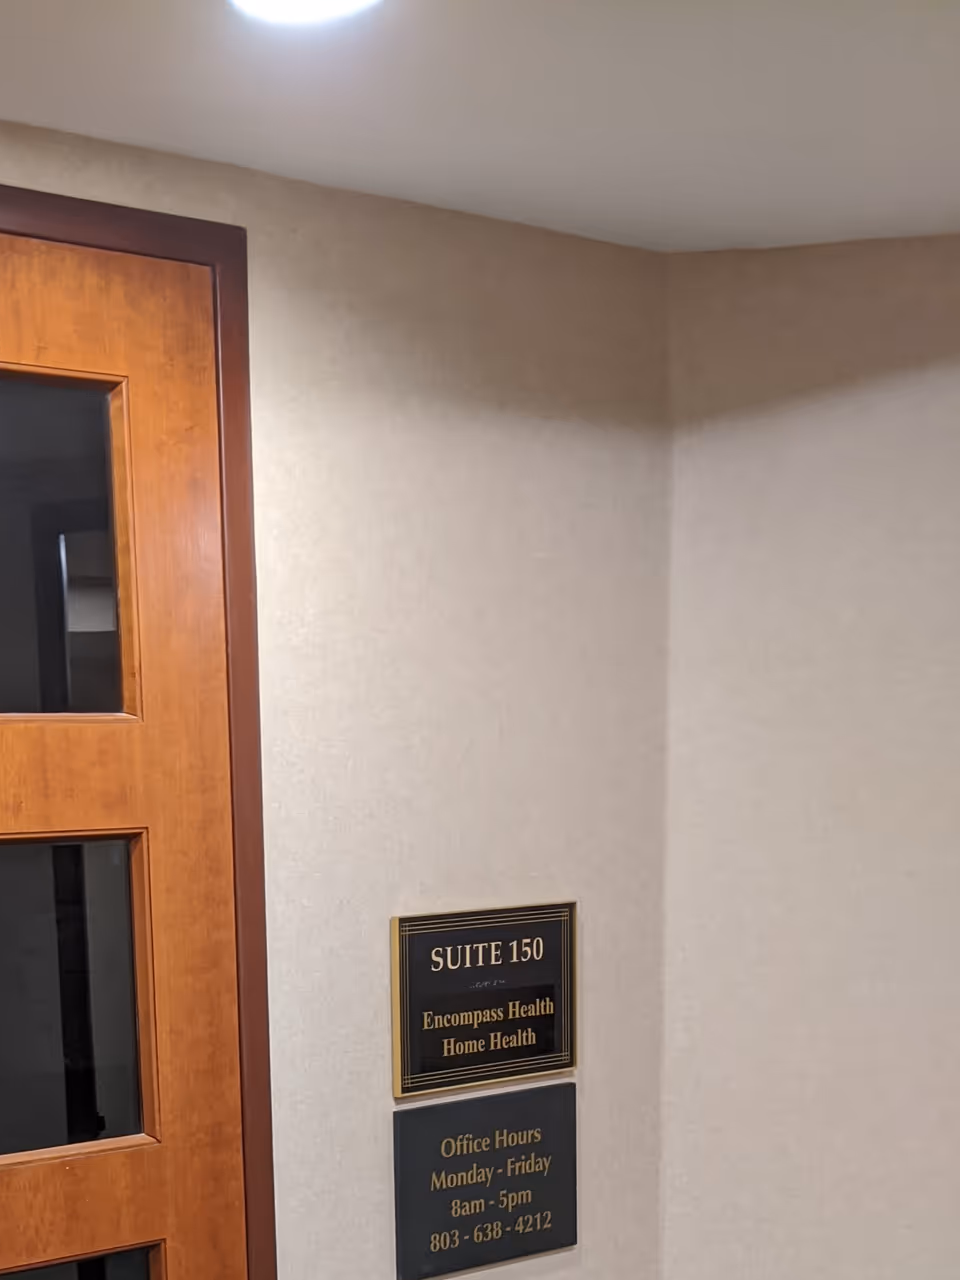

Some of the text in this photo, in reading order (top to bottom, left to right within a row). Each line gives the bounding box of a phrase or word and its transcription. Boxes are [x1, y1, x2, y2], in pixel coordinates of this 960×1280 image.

[431, 936, 544, 972] SUITE 150
[422, 996, 555, 1030] Encompass Health
[442, 1027, 537, 1057] Home Health
[441, 1127, 542, 1158] Office Hours
[431, 1163, 494, 1191] Monday
[507, 1152, 552, 1176] Friday
[451, 1198, 485, 1218] 8am
[499, 1189, 532, 1212] 5pm
[430, 1230, 460, 1252] 803
[473, 1221, 502, 1243] 638
[515, 1211, 552, 1234] 4212
